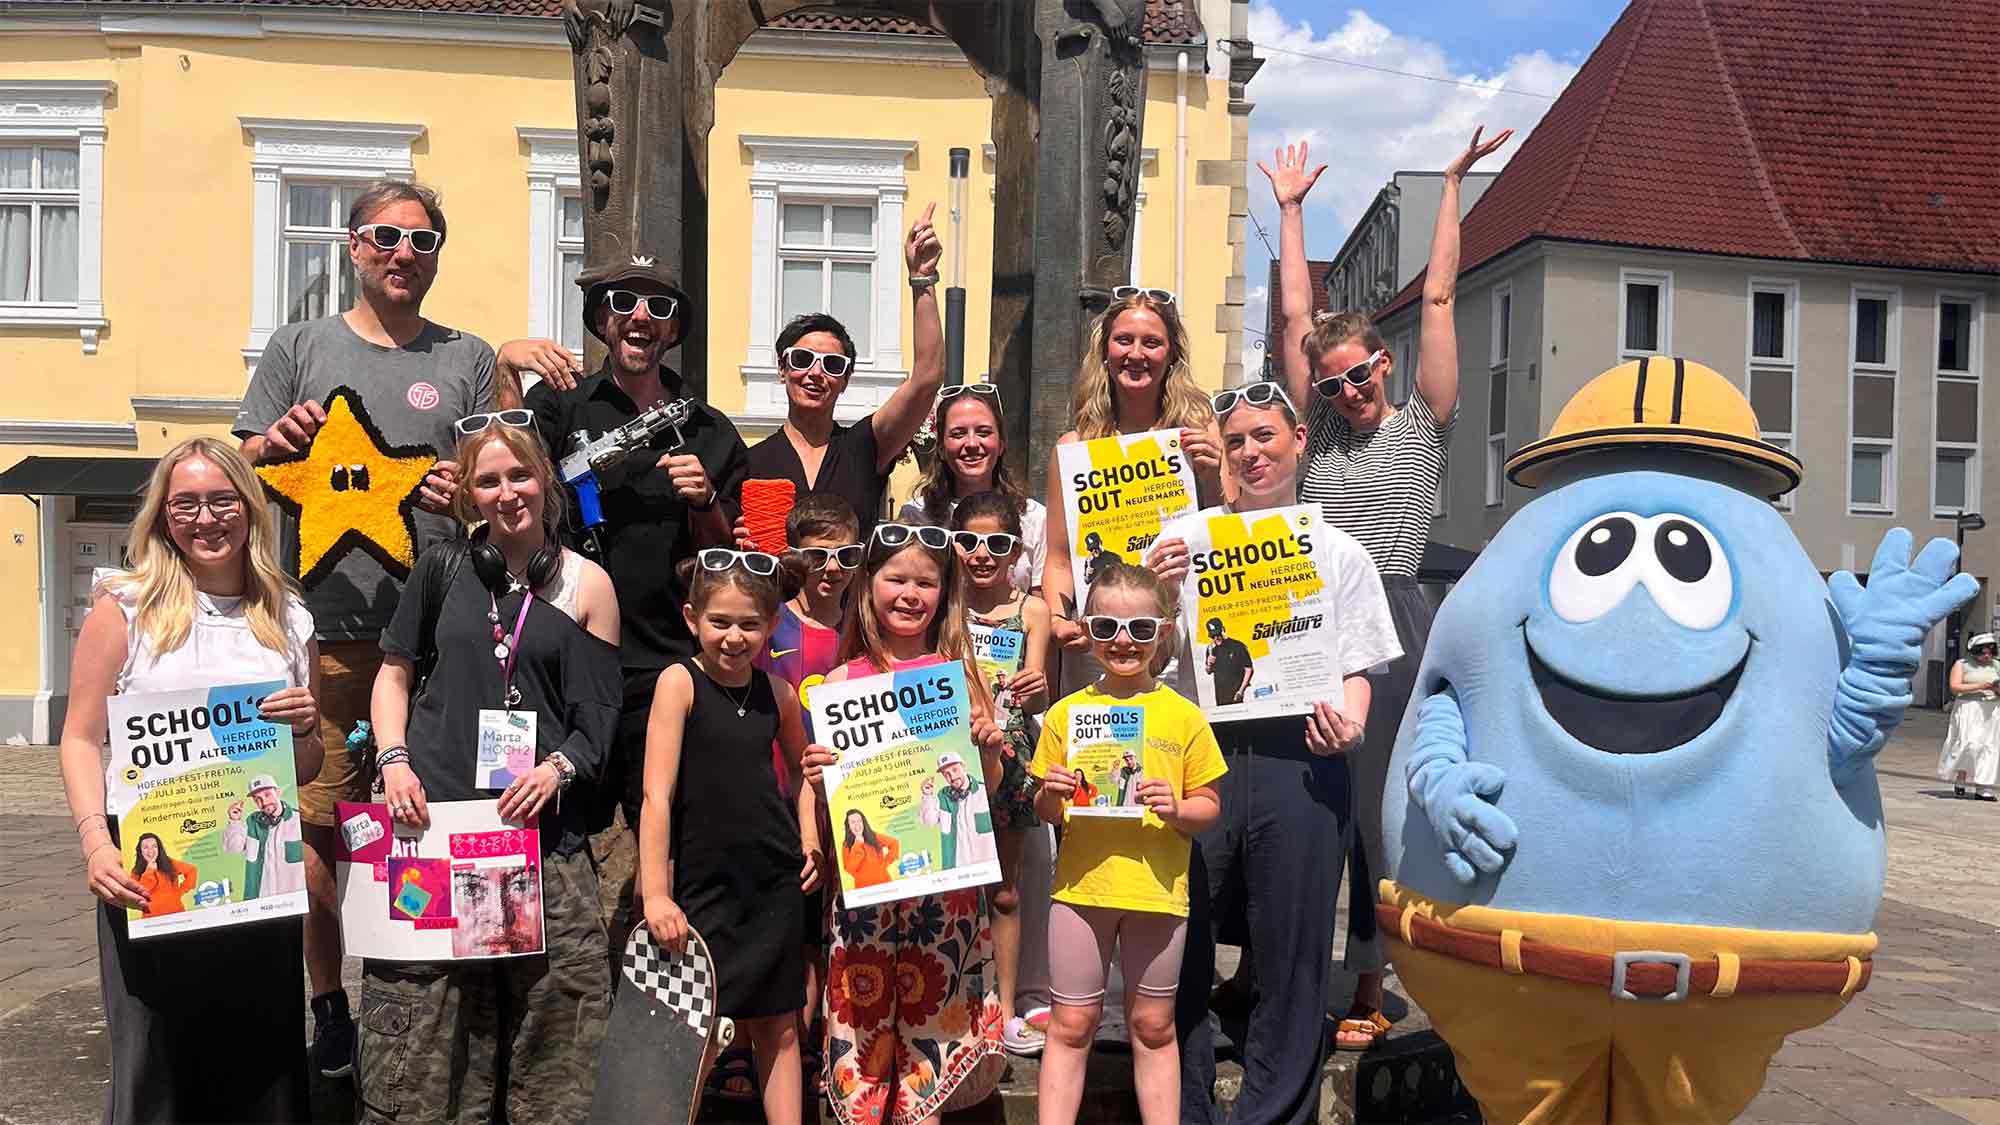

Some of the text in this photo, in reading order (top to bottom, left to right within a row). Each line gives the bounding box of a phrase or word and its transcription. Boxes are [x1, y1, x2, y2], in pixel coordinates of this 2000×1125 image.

[1073, 455, 1182, 492] SCHOOL'S
[1144, 479, 1184, 493] HERFORD
[1078, 489, 1122, 515] OUT
[1125, 489, 1186, 506] NEUER MARKT
[1191, 533, 1313, 574] SCHOOL'S
[1271, 560, 1317, 576] HERFORD
[1197, 571, 1246, 599] OUT
[1250, 570, 1318, 590] NEUER MARKT
[825, 677, 954, 726] SCHOOL'S
[910, 706, 958, 724] HERFORD
[1075, 712, 1139, 726] SCHOOL'S
[222, 727, 277, 744] HERFORD
[484, 729, 521, 742] Marta
[832, 720, 885, 751] OUT
[891, 716, 960, 740] ALTER MARKT
[1075, 727, 1102, 739] OUT
[131, 737, 193, 769] OUT
[199, 738, 280, 760] ALTER MARKT
[483, 743, 530, 756] HOCH 2
[894, 759, 912, 768] UHR
[908, 767, 926, 777] LENA
[154, 788, 174, 799] JULI
[175, 787, 186, 795] ab
[189, 784, 199, 792] 13
[200, 780, 221, 790] UHR
[215, 791, 235, 800] LENA
[847, 785, 895, 801] Kindermusik
[143, 805, 216, 825] Kindermusik mit
